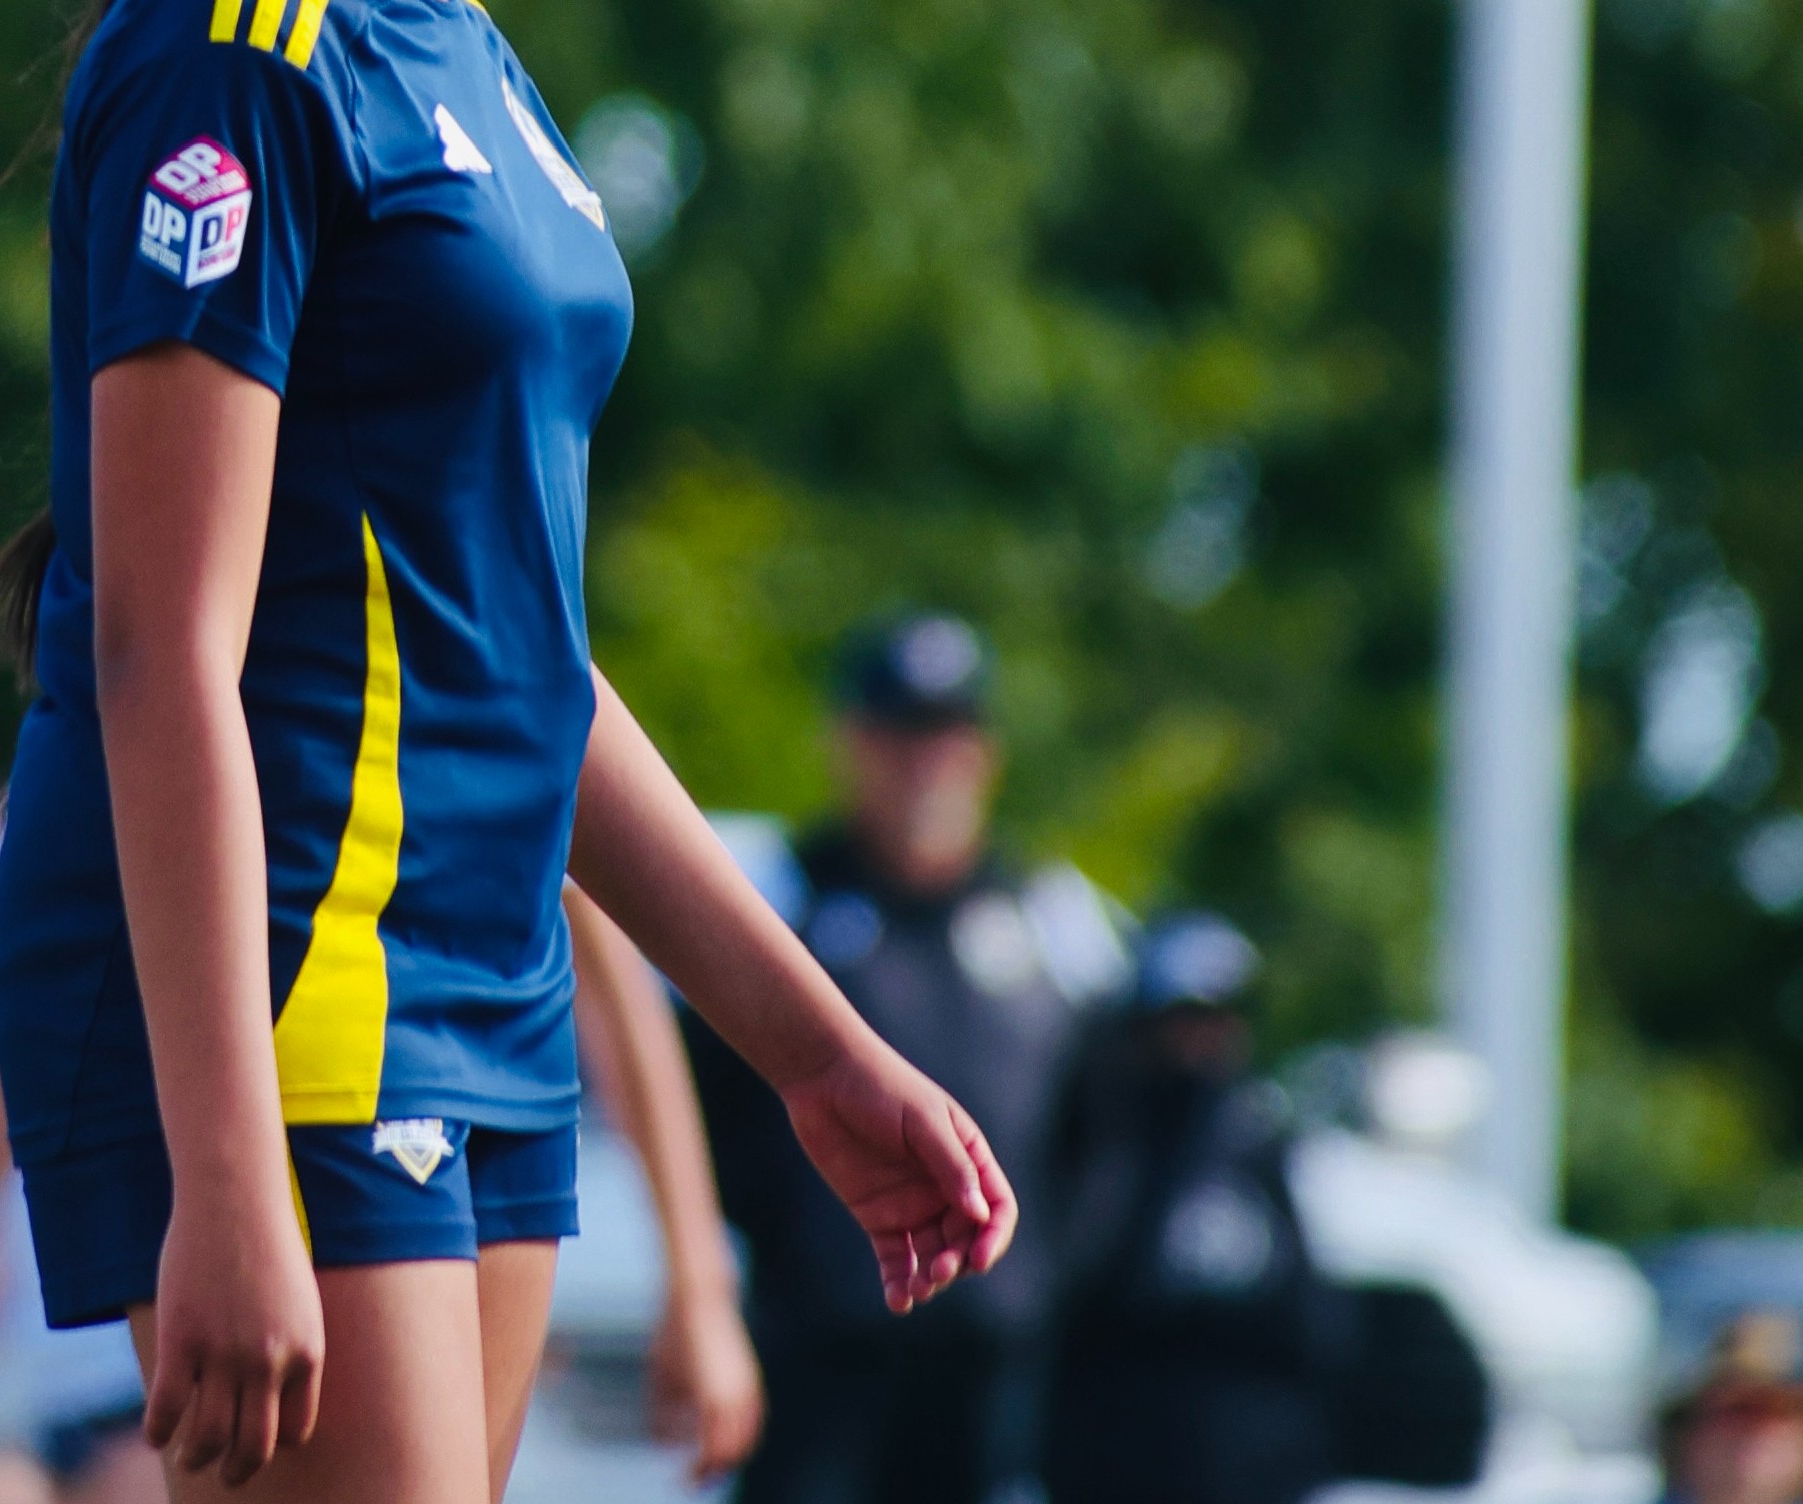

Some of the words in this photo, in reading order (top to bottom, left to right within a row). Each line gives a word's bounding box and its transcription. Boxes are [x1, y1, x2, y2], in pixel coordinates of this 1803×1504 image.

[154, 142, 222, 193] DP
[142, 191, 187, 247] DP
[200, 204, 244, 251] DP
